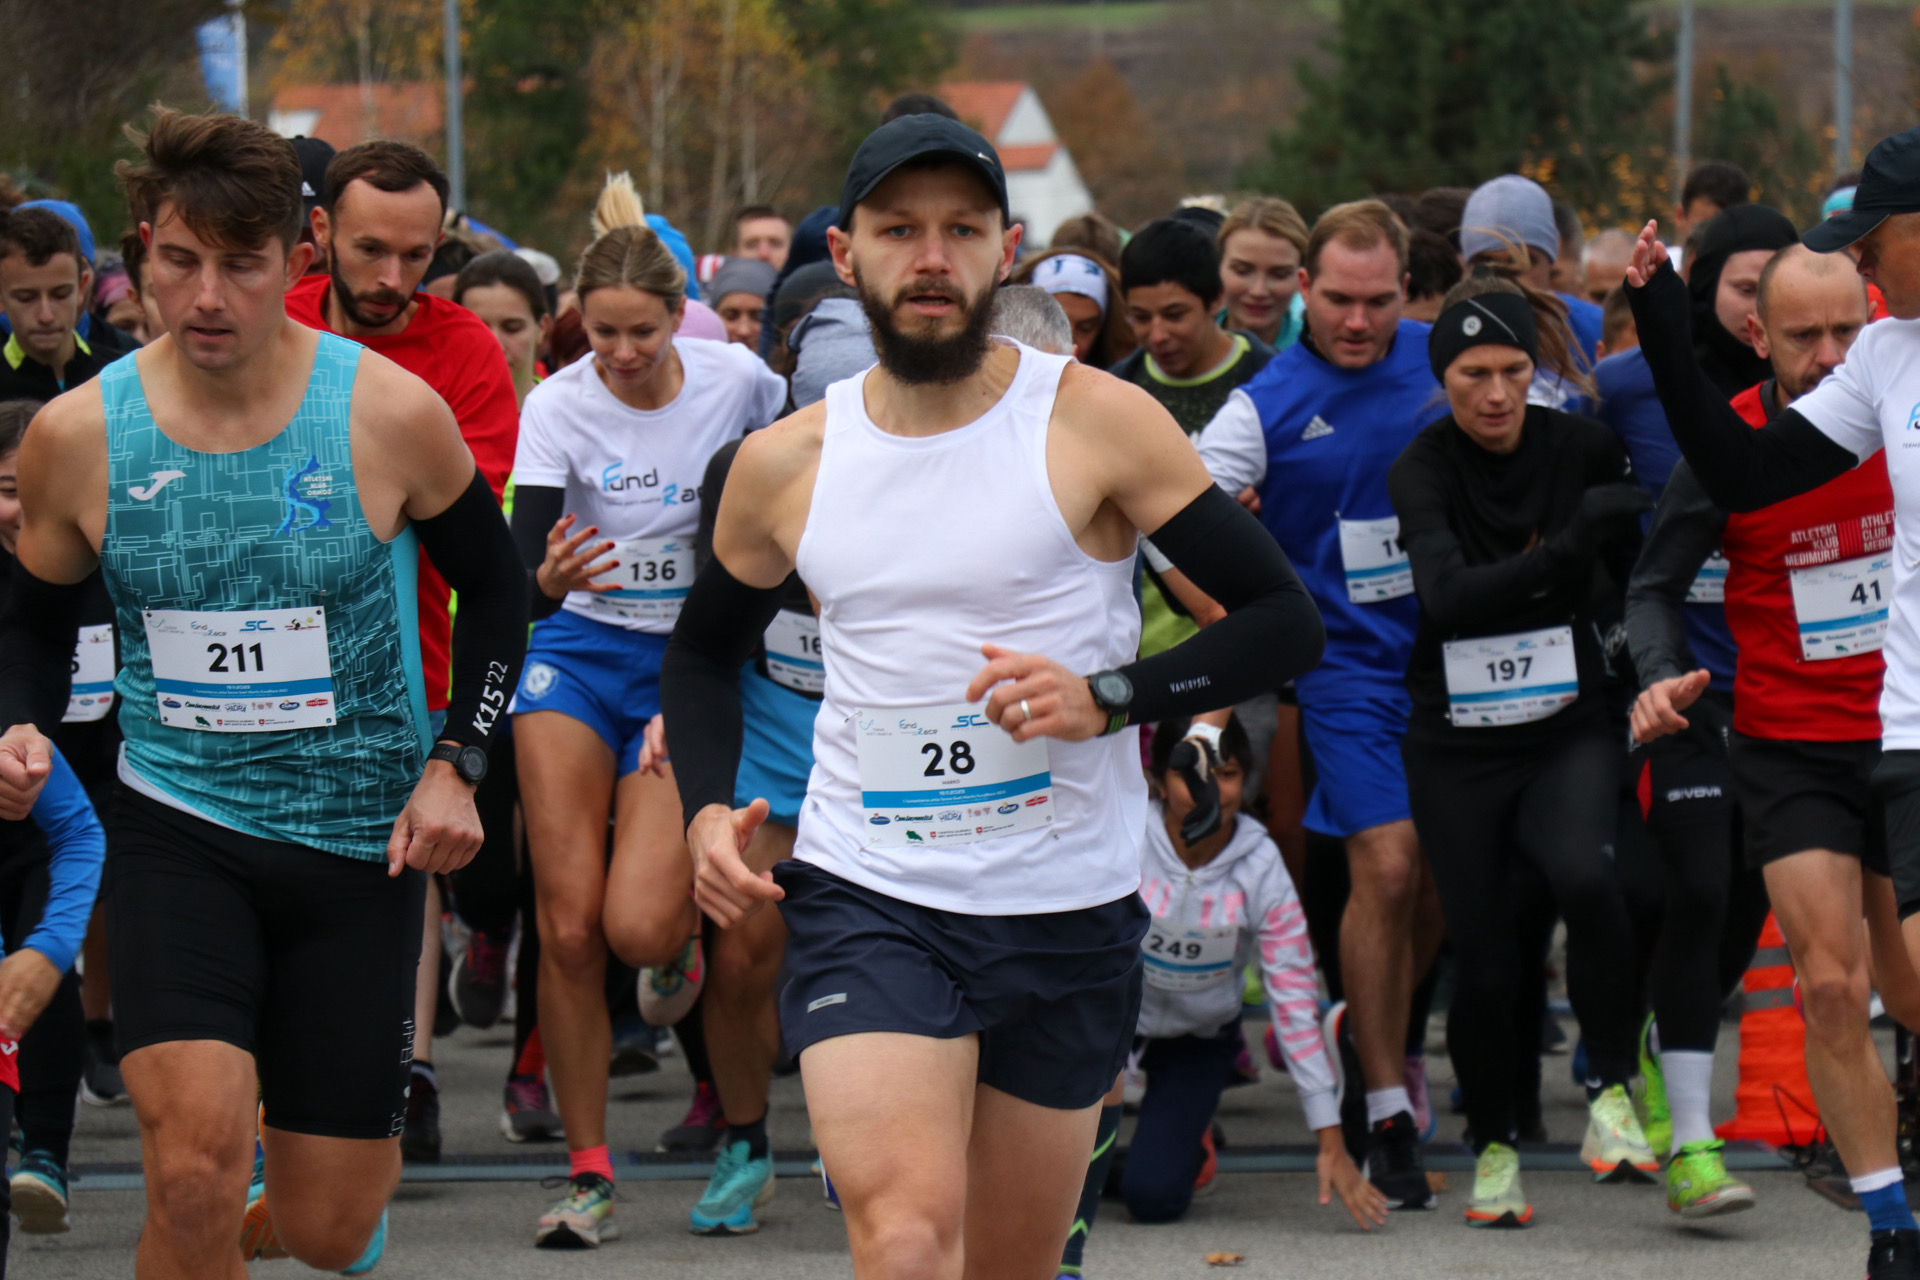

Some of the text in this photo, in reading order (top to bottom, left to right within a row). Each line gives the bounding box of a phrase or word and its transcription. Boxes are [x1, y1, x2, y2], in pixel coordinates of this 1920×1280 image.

[603, 462, 658, 492] Fund
[1861, 511, 1896, 529] ATHLET
[1791, 523, 1837, 545] ATLETSKI
[1812, 536, 1839, 551] KLUB
[1862, 524, 1887, 541] CLUB
[630, 560, 676, 581] 136
[1850, 579, 1882, 605] 41
[239, 620, 275, 632] SC
[799, 635, 822, 655] 16
[206, 642, 264, 672] 211
[1486, 656, 1533, 682] 197
[472, 661, 508, 736] K15'22
[951, 713, 989, 729] SC
[921, 740, 975, 777] 28
[1150, 934, 1202, 959] 249
